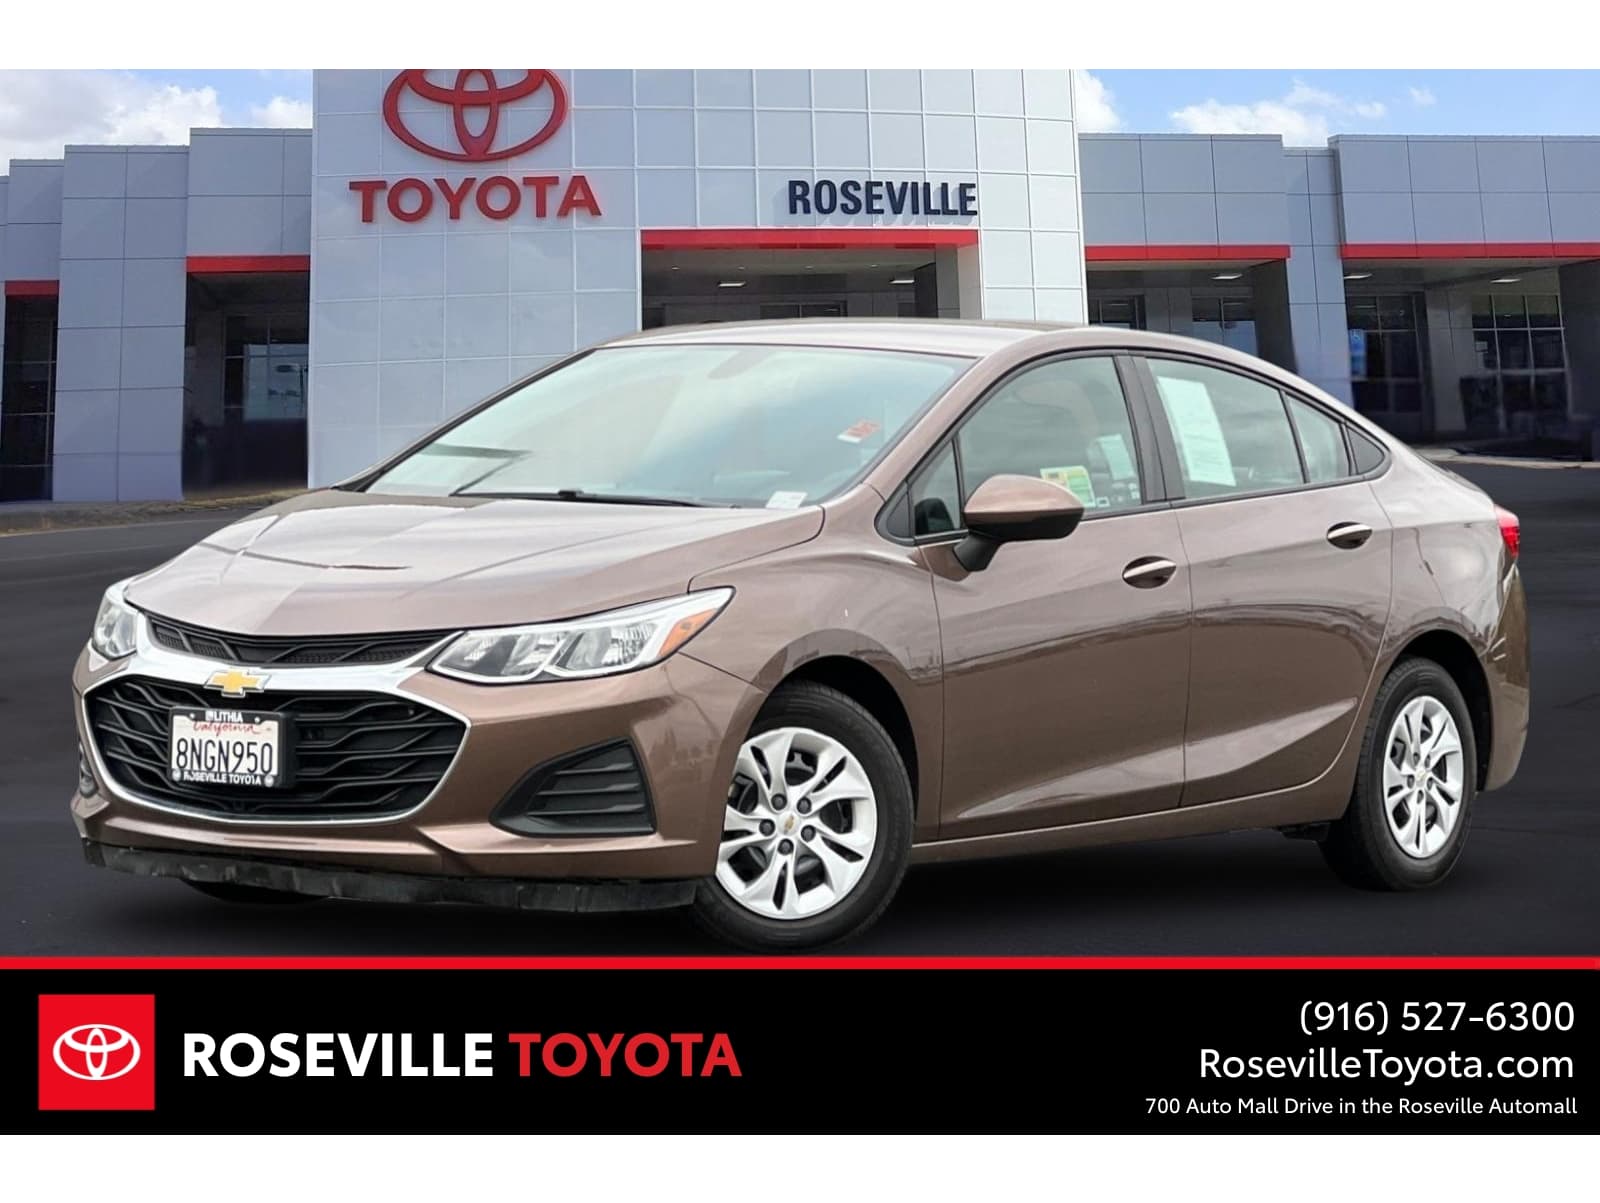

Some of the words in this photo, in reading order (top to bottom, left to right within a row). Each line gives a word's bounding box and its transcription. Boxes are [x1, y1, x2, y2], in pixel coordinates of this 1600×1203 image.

[349, 175, 602, 223] TOYOTA
[788, 180, 978, 217] ROSEVILLE
[193, 721, 260, 736] California
[214, 711, 243, 723] LITHIA
[176, 738, 273, 774] 8NGN950
[183, 772, 228, 784] ROSEVILLE
[229, 774, 262, 785] TOYOTA
